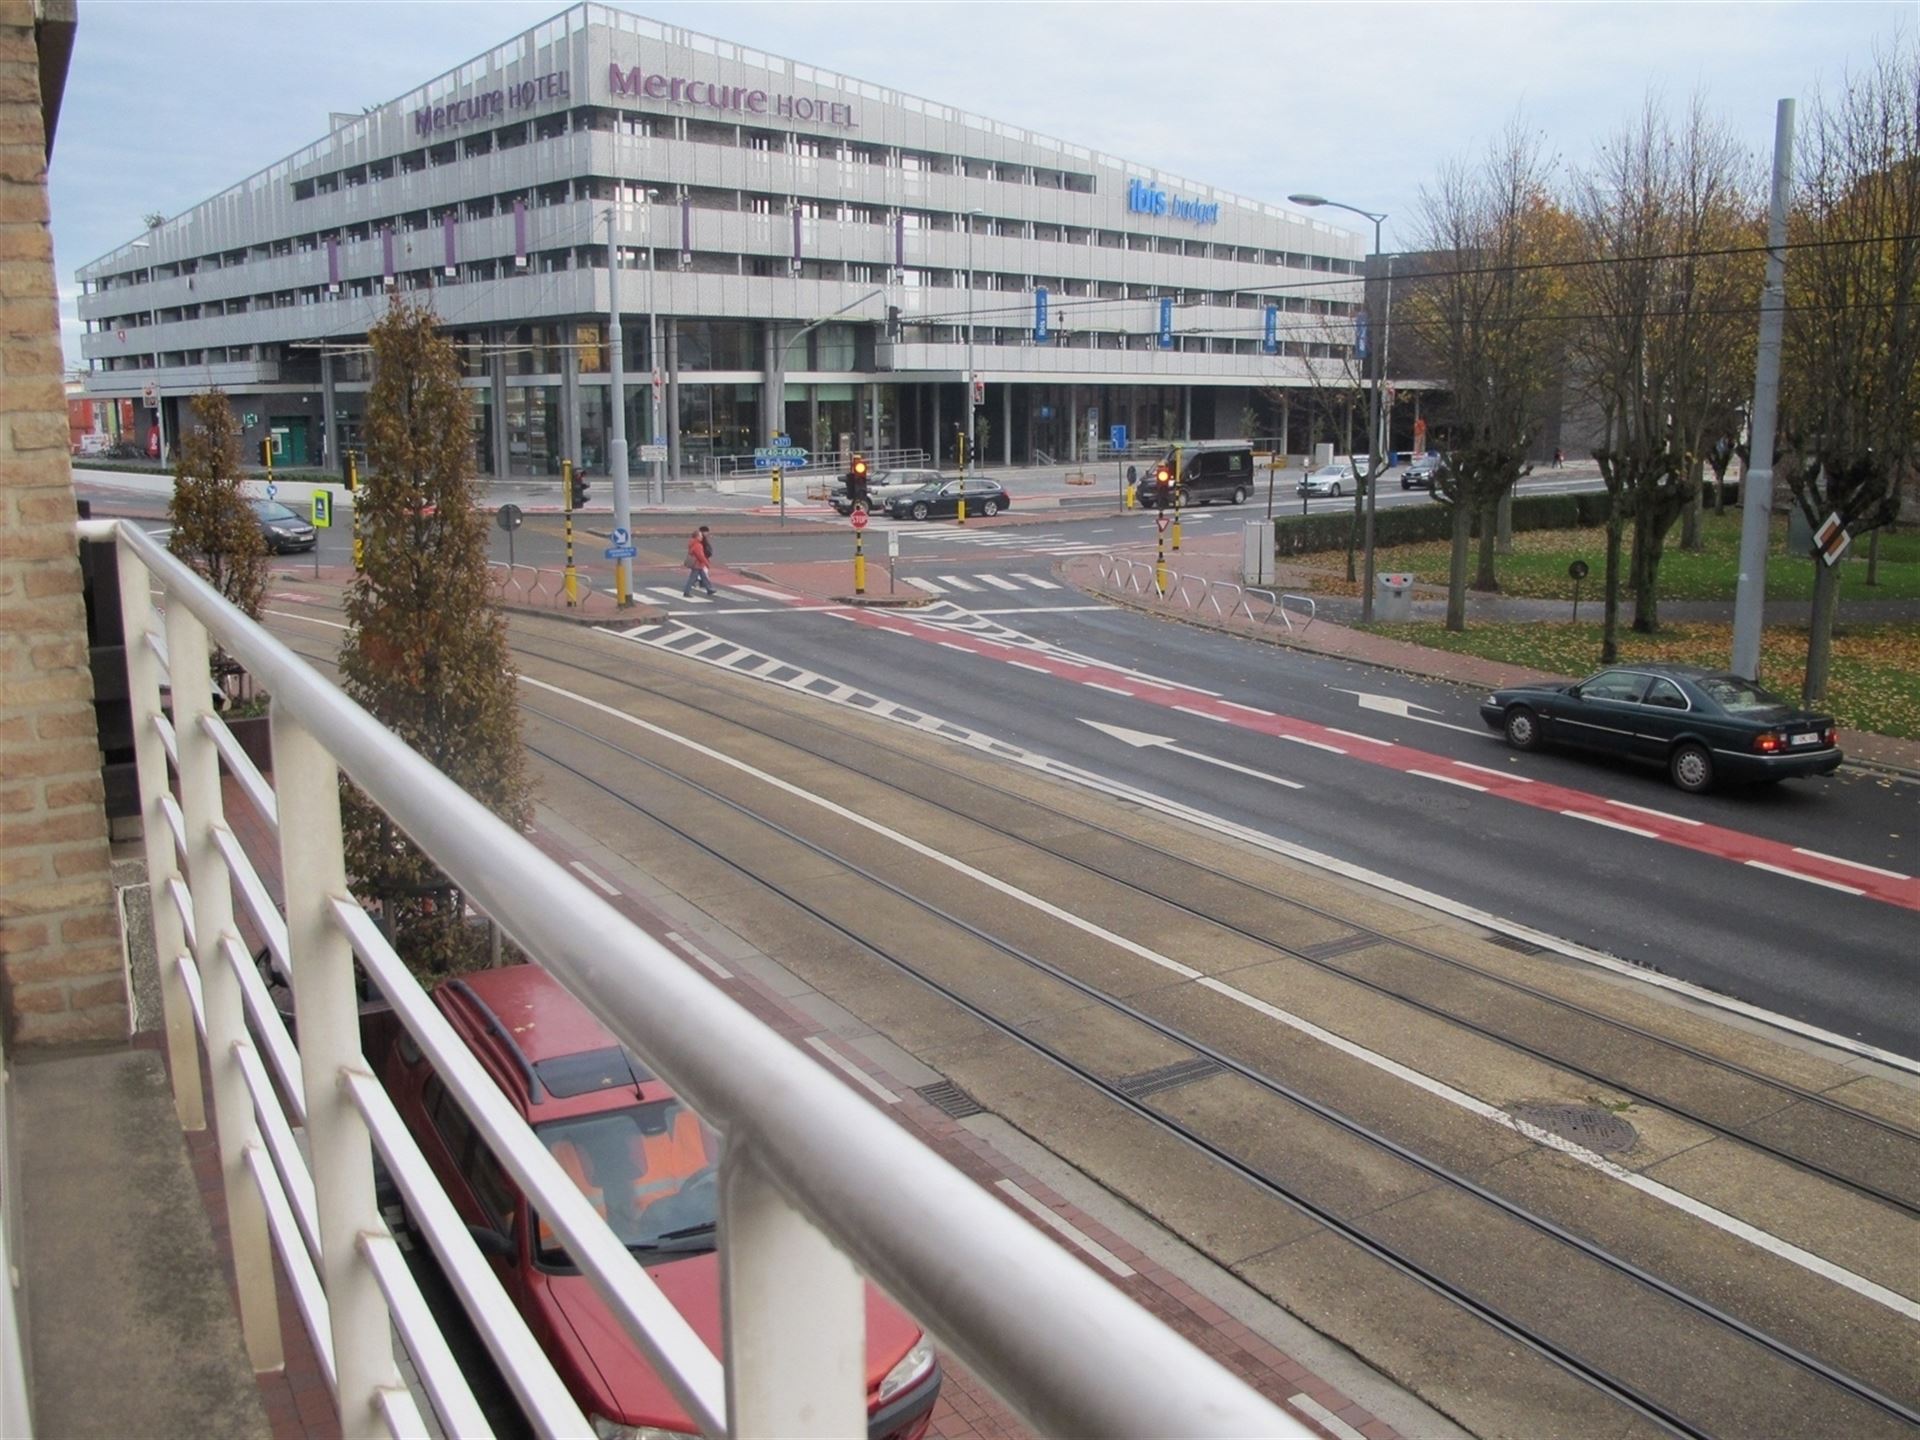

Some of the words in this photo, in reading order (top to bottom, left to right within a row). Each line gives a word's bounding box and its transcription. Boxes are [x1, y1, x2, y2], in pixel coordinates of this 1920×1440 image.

[415, 89, 504, 137] Mercure
[508, 70, 570, 110] HOTEL
[609, 62, 768, 114] Mercure
[777, 93, 860, 128] HOTEL
[1128, 177, 1167, 217] ibis
[1171, 194, 1218, 225] budget
[851, 514, 868, 524] STOP
